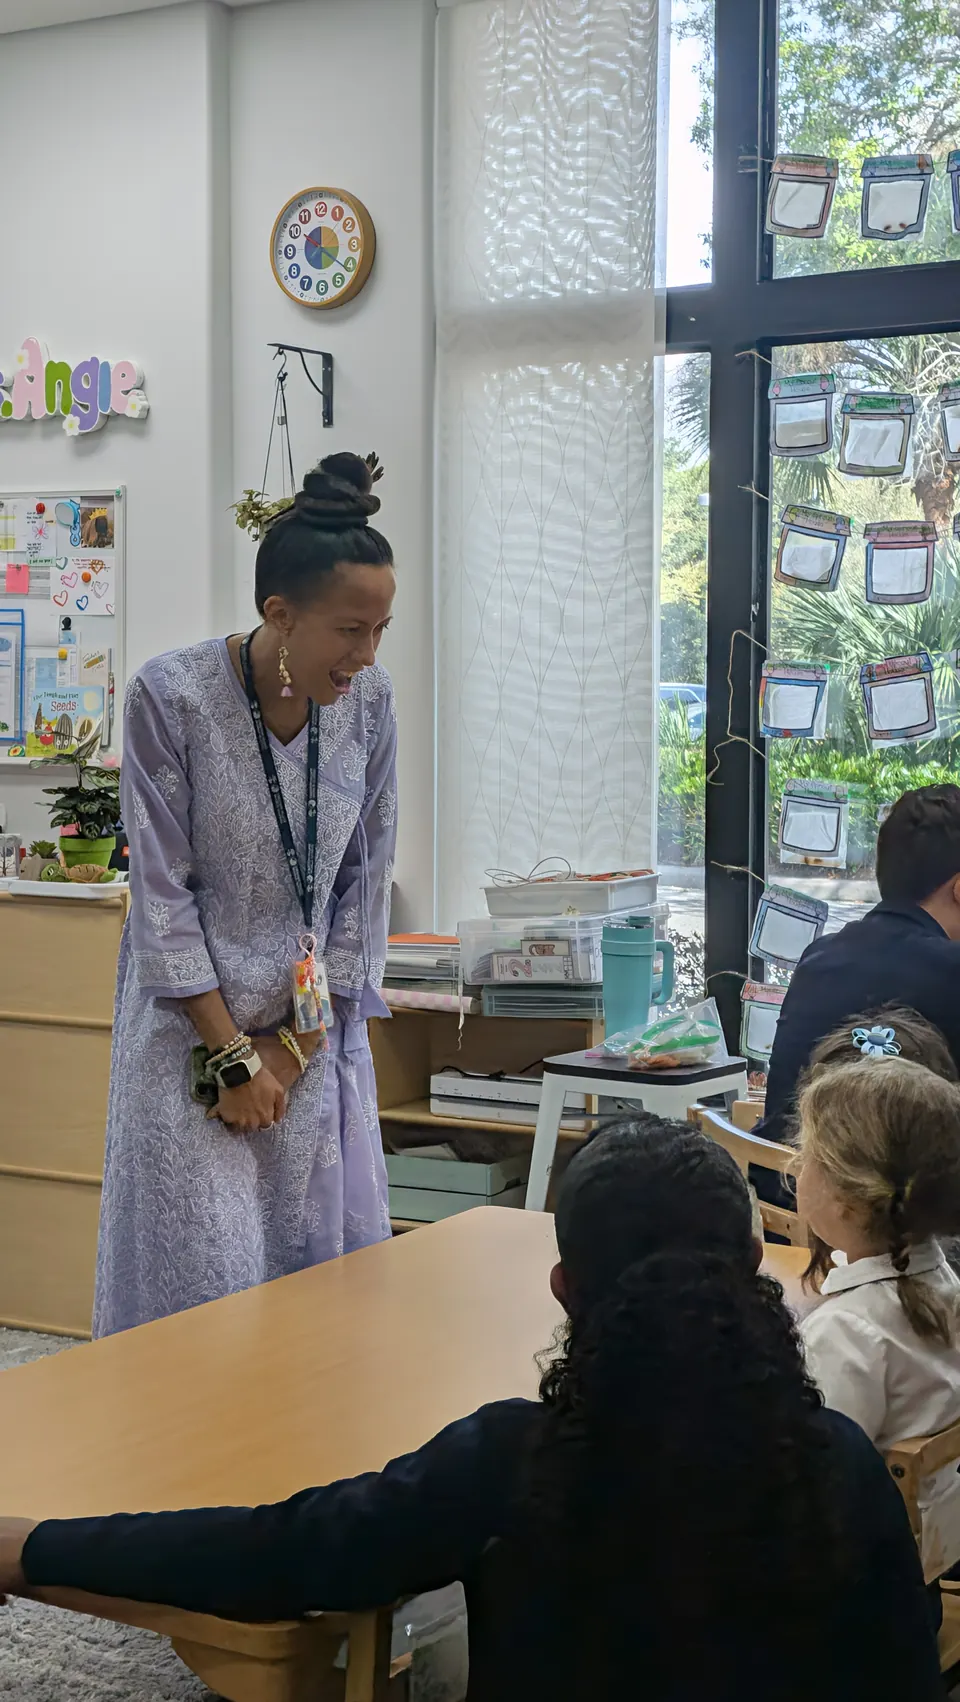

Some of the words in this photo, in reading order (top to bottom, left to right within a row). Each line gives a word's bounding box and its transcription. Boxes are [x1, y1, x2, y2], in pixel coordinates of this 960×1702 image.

[315, 203, 326, 216] 12
[299, 211, 310, 223] 11
[289, 224, 301, 238] 10
[51, 700, 77, 711] Seeds
